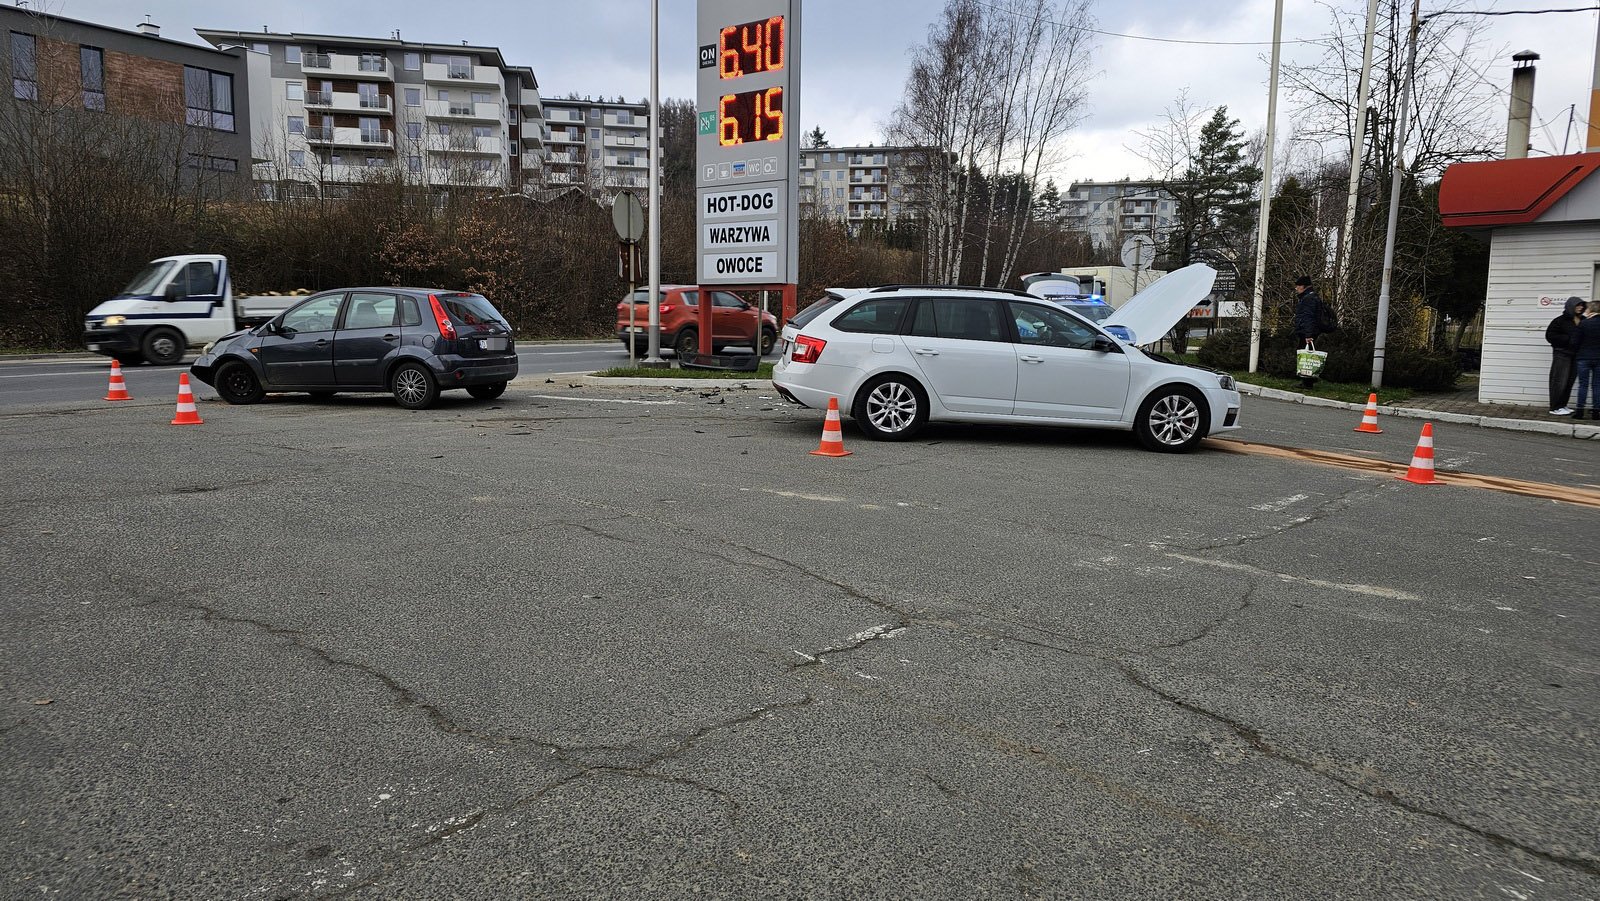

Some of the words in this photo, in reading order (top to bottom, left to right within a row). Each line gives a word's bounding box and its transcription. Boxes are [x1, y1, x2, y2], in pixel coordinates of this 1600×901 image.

[701, 47, 715, 60] ON
[748, 162, 760, 173] WC
[707, 192, 774, 213] HOT-DOG
[709, 225, 770, 244] WARZYWA
[716, 256, 763, 274] OWOCE
